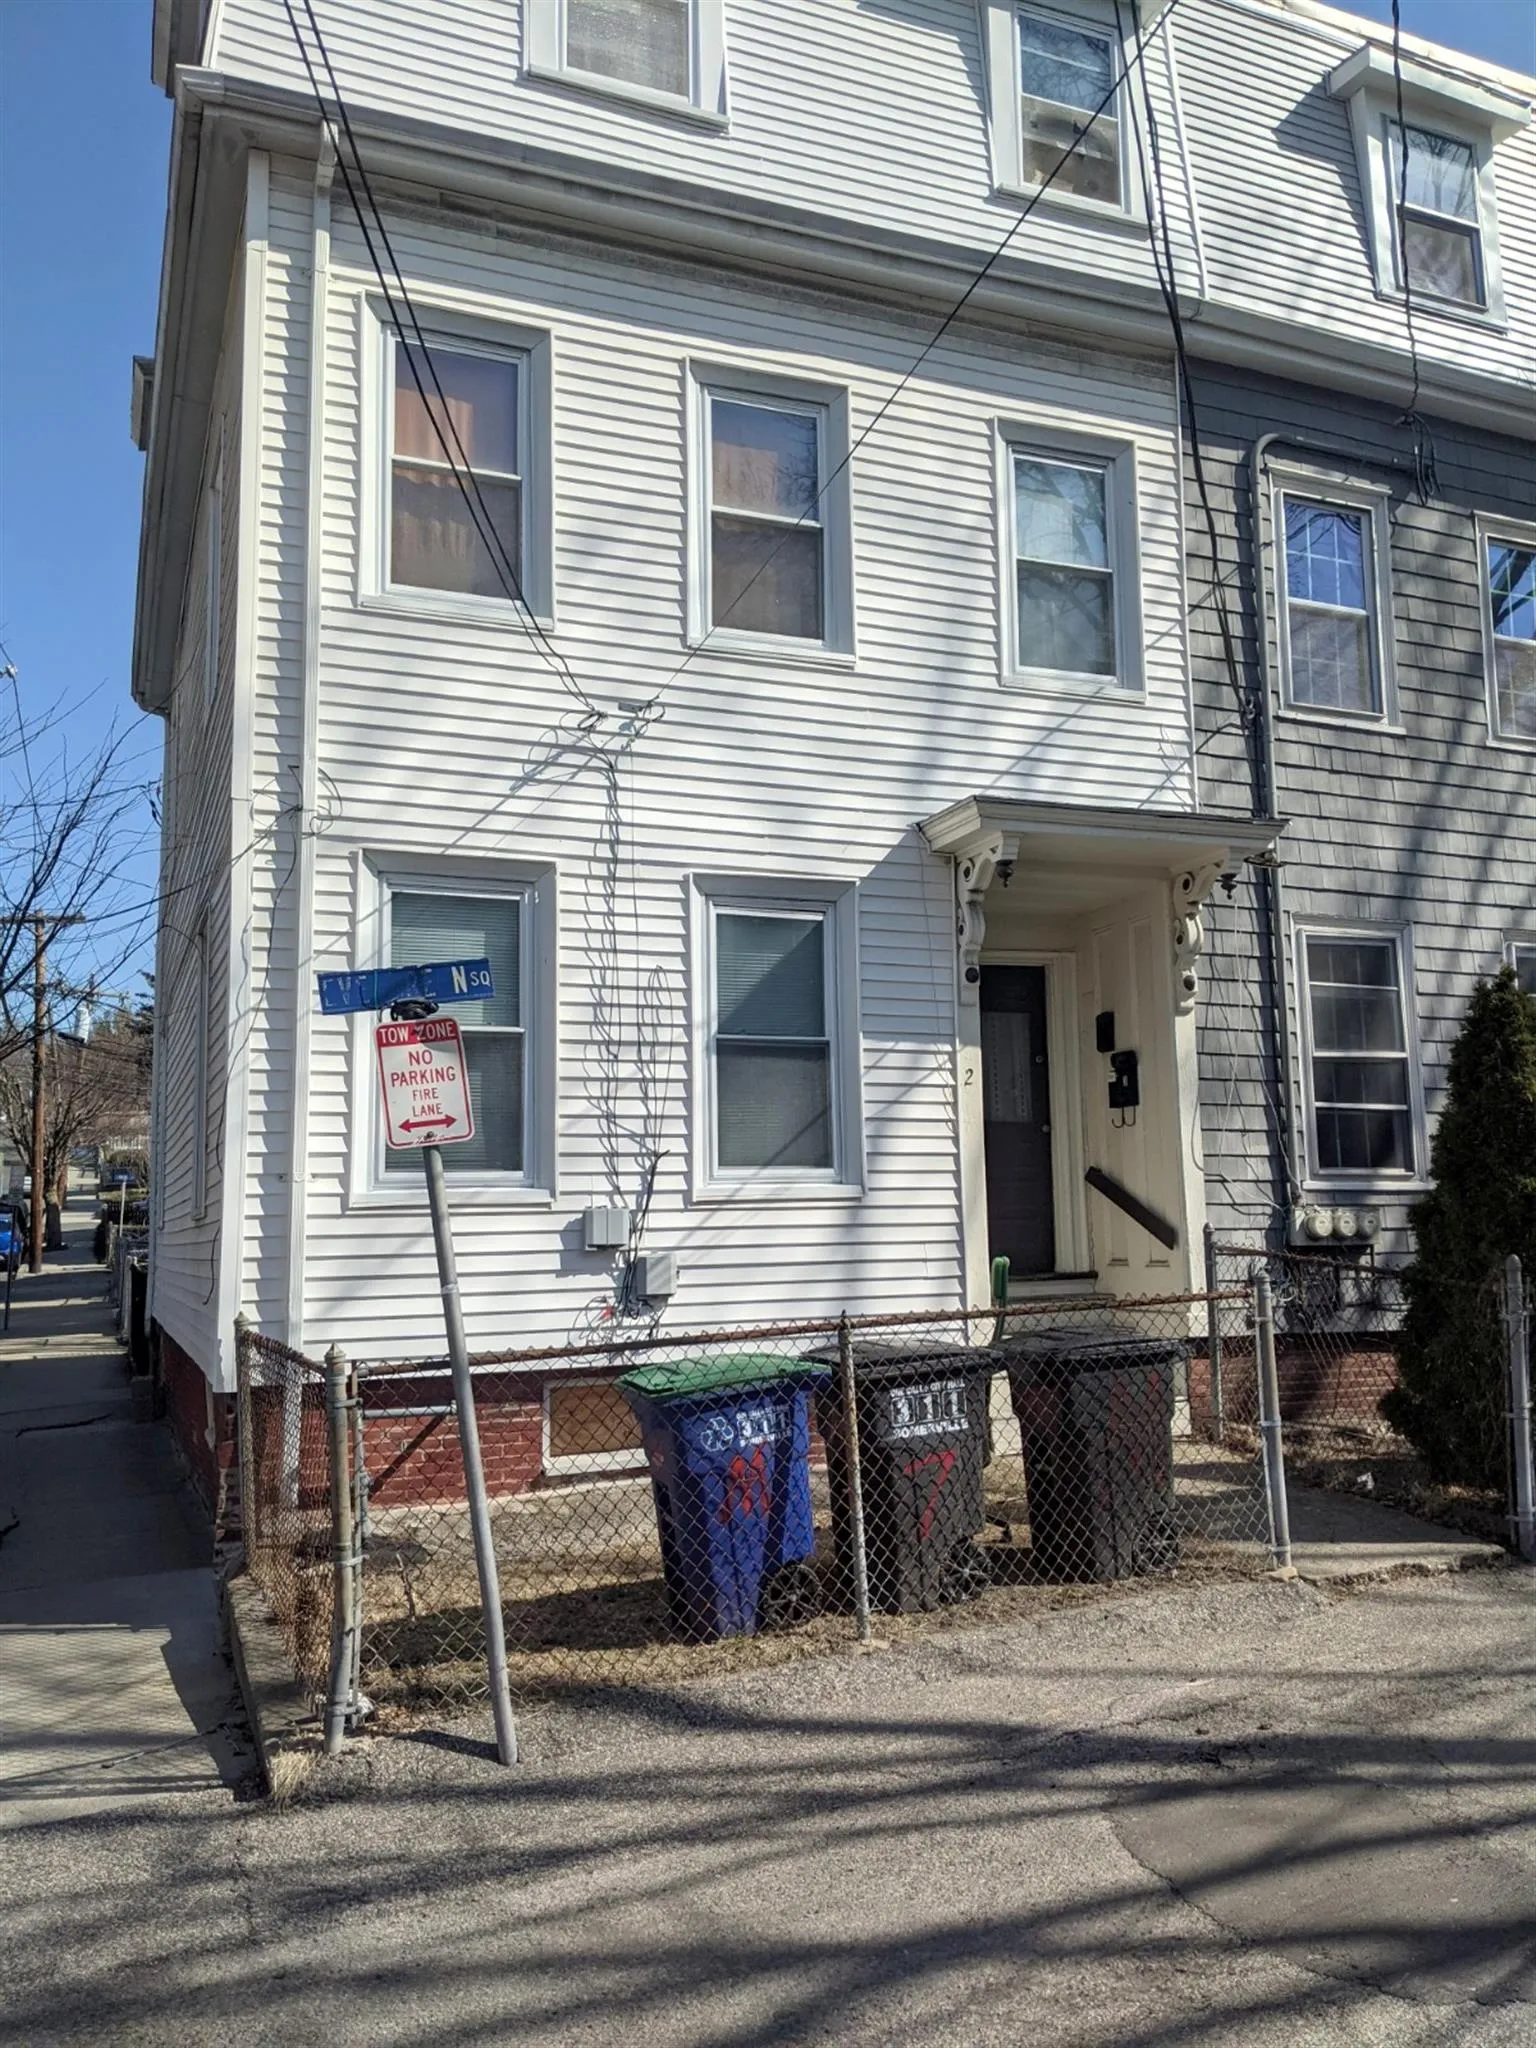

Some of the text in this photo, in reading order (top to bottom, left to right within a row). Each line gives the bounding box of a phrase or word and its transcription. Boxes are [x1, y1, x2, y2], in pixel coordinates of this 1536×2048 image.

[470, 970, 491, 987] SQ
[379, 1021, 456, 1044] TOW ZONE
[408, 1049, 434, 1066] NO
[391, 1066, 456, 1087] PARKING
[964, 1067, 974, 1087] 2
[412, 1087, 439, 1102] FIRE
[412, 1102, 443, 1118] LANE
[895, 1391, 960, 1422] 311
